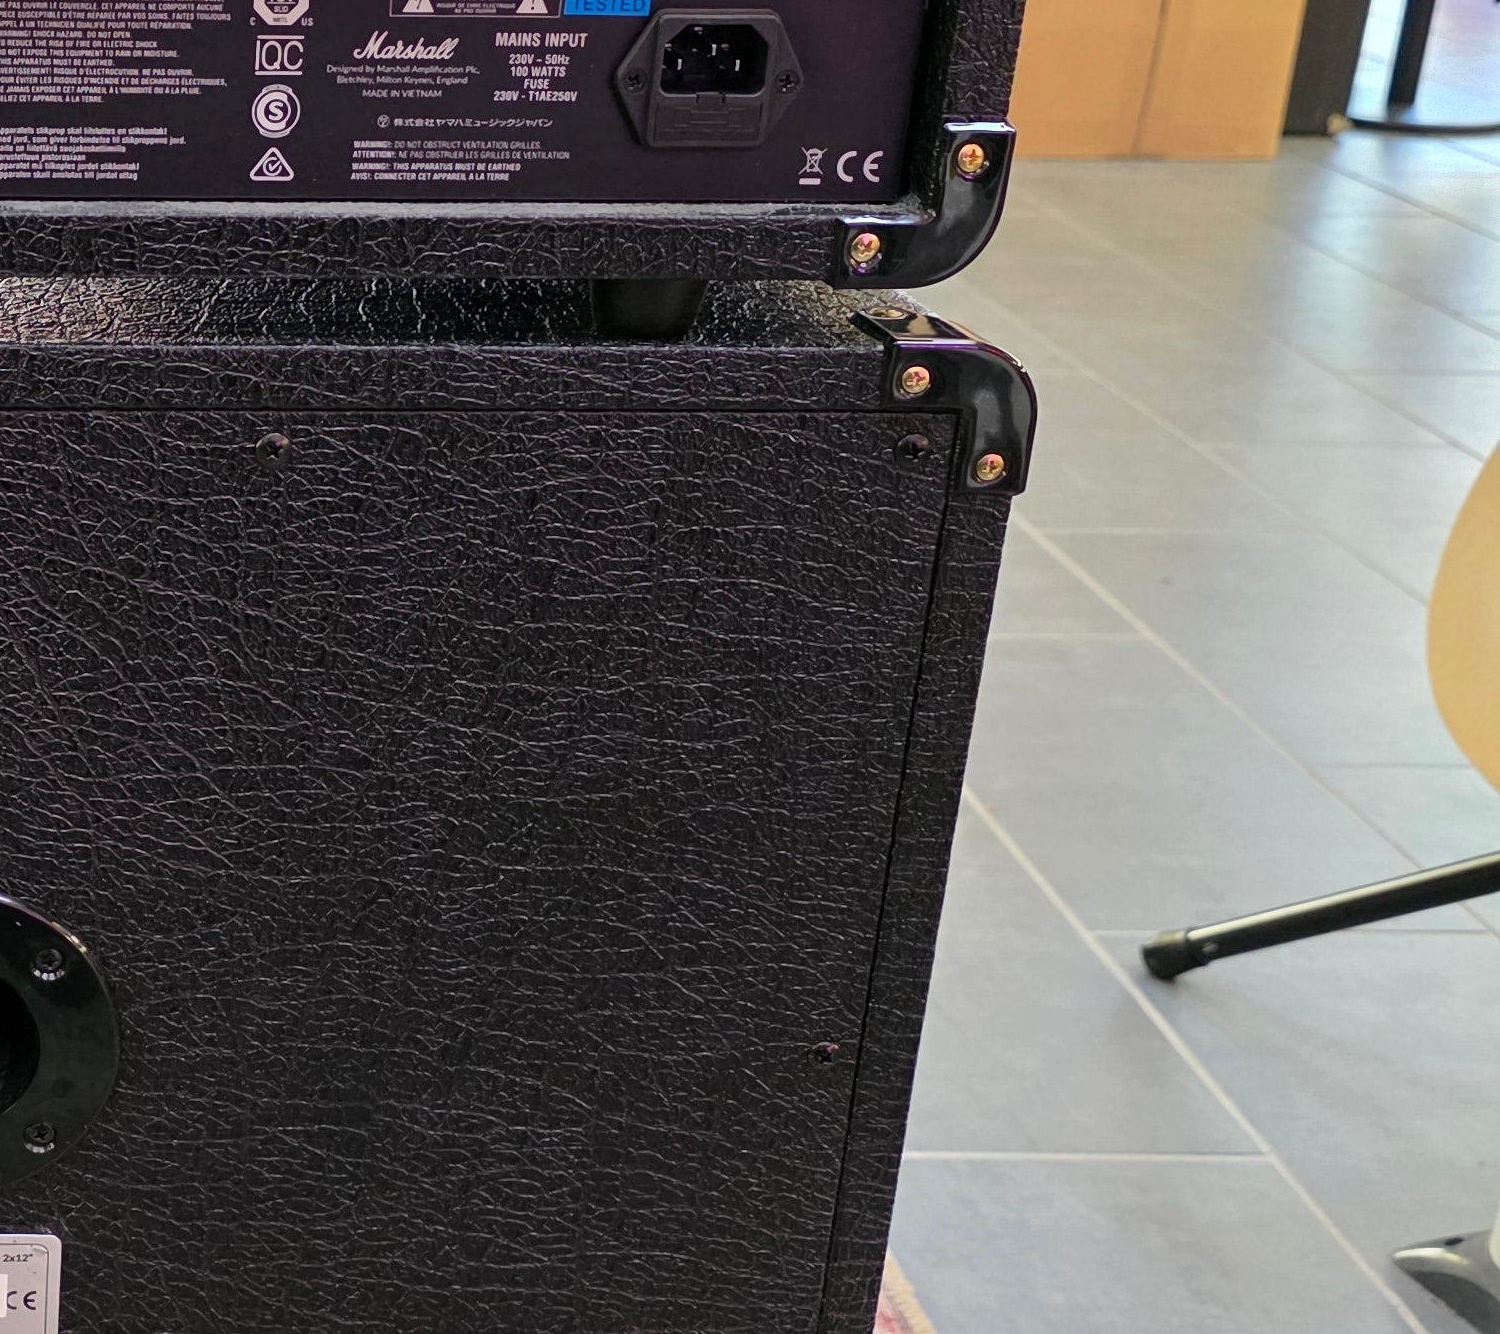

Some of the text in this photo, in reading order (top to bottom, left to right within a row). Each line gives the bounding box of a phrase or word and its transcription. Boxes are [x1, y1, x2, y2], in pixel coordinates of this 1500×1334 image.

[301, 17, 314, 27] US
[352, 30, 459, 60] Marshall
[496, 32, 587, 48] MAINS INPUT
[509, 54, 534, 65] 230V
[546, 54, 569, 65] 50Hz
[326, 64, 364, 74] Designed
[365, 65, 375, 74] by
[377, 65, 410, 73] Marshall
[511, 66, 566, 77] 100 WATTS
[376, 76, 402, 84] Milton
[436, 76, 468, 86] England
[523, 79, 550, 90] FUSE
[362, 89, 442, 98] MADE IN VIETNAM
[494, 91, 519, 101] 230V
[836, 150, 884, 183] CE
